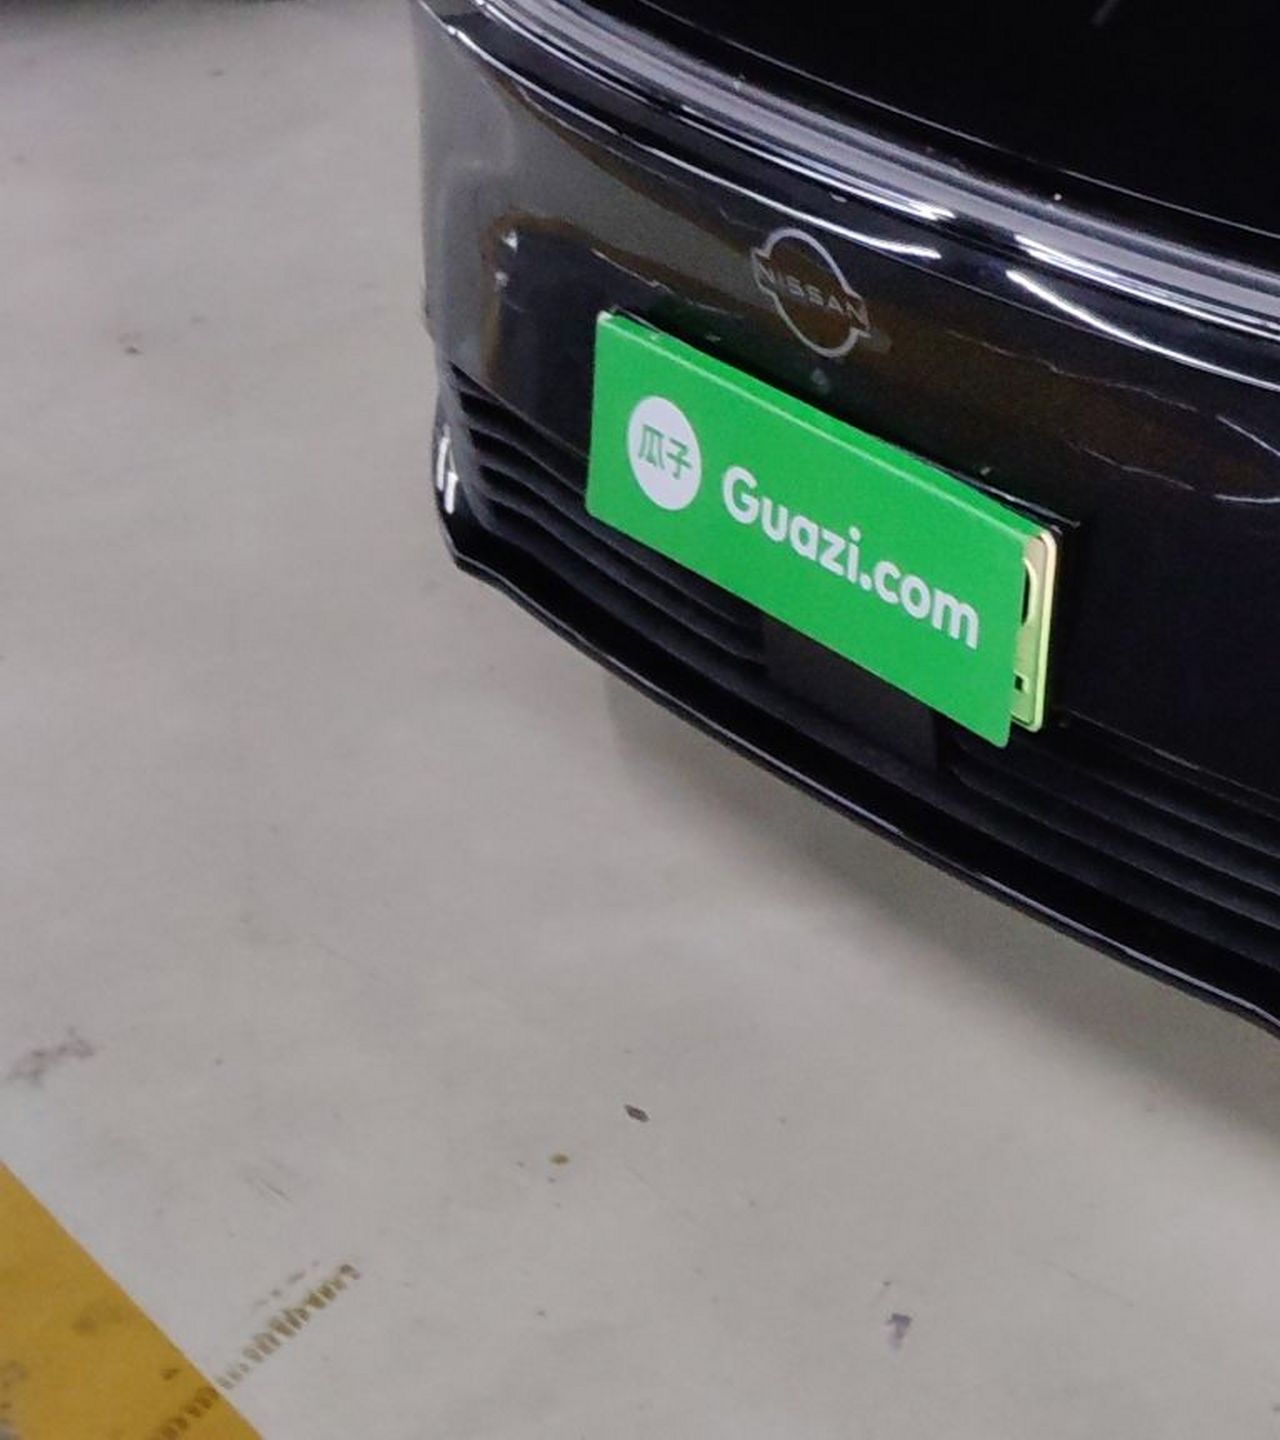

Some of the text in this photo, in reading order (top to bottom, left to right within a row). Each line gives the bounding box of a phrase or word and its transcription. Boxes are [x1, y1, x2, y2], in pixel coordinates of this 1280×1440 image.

[757, 262, 869, 330] NISSAN
[637, 423, 693, 481] 瓜子
[721, 465, 979, 650] Guazi.com
